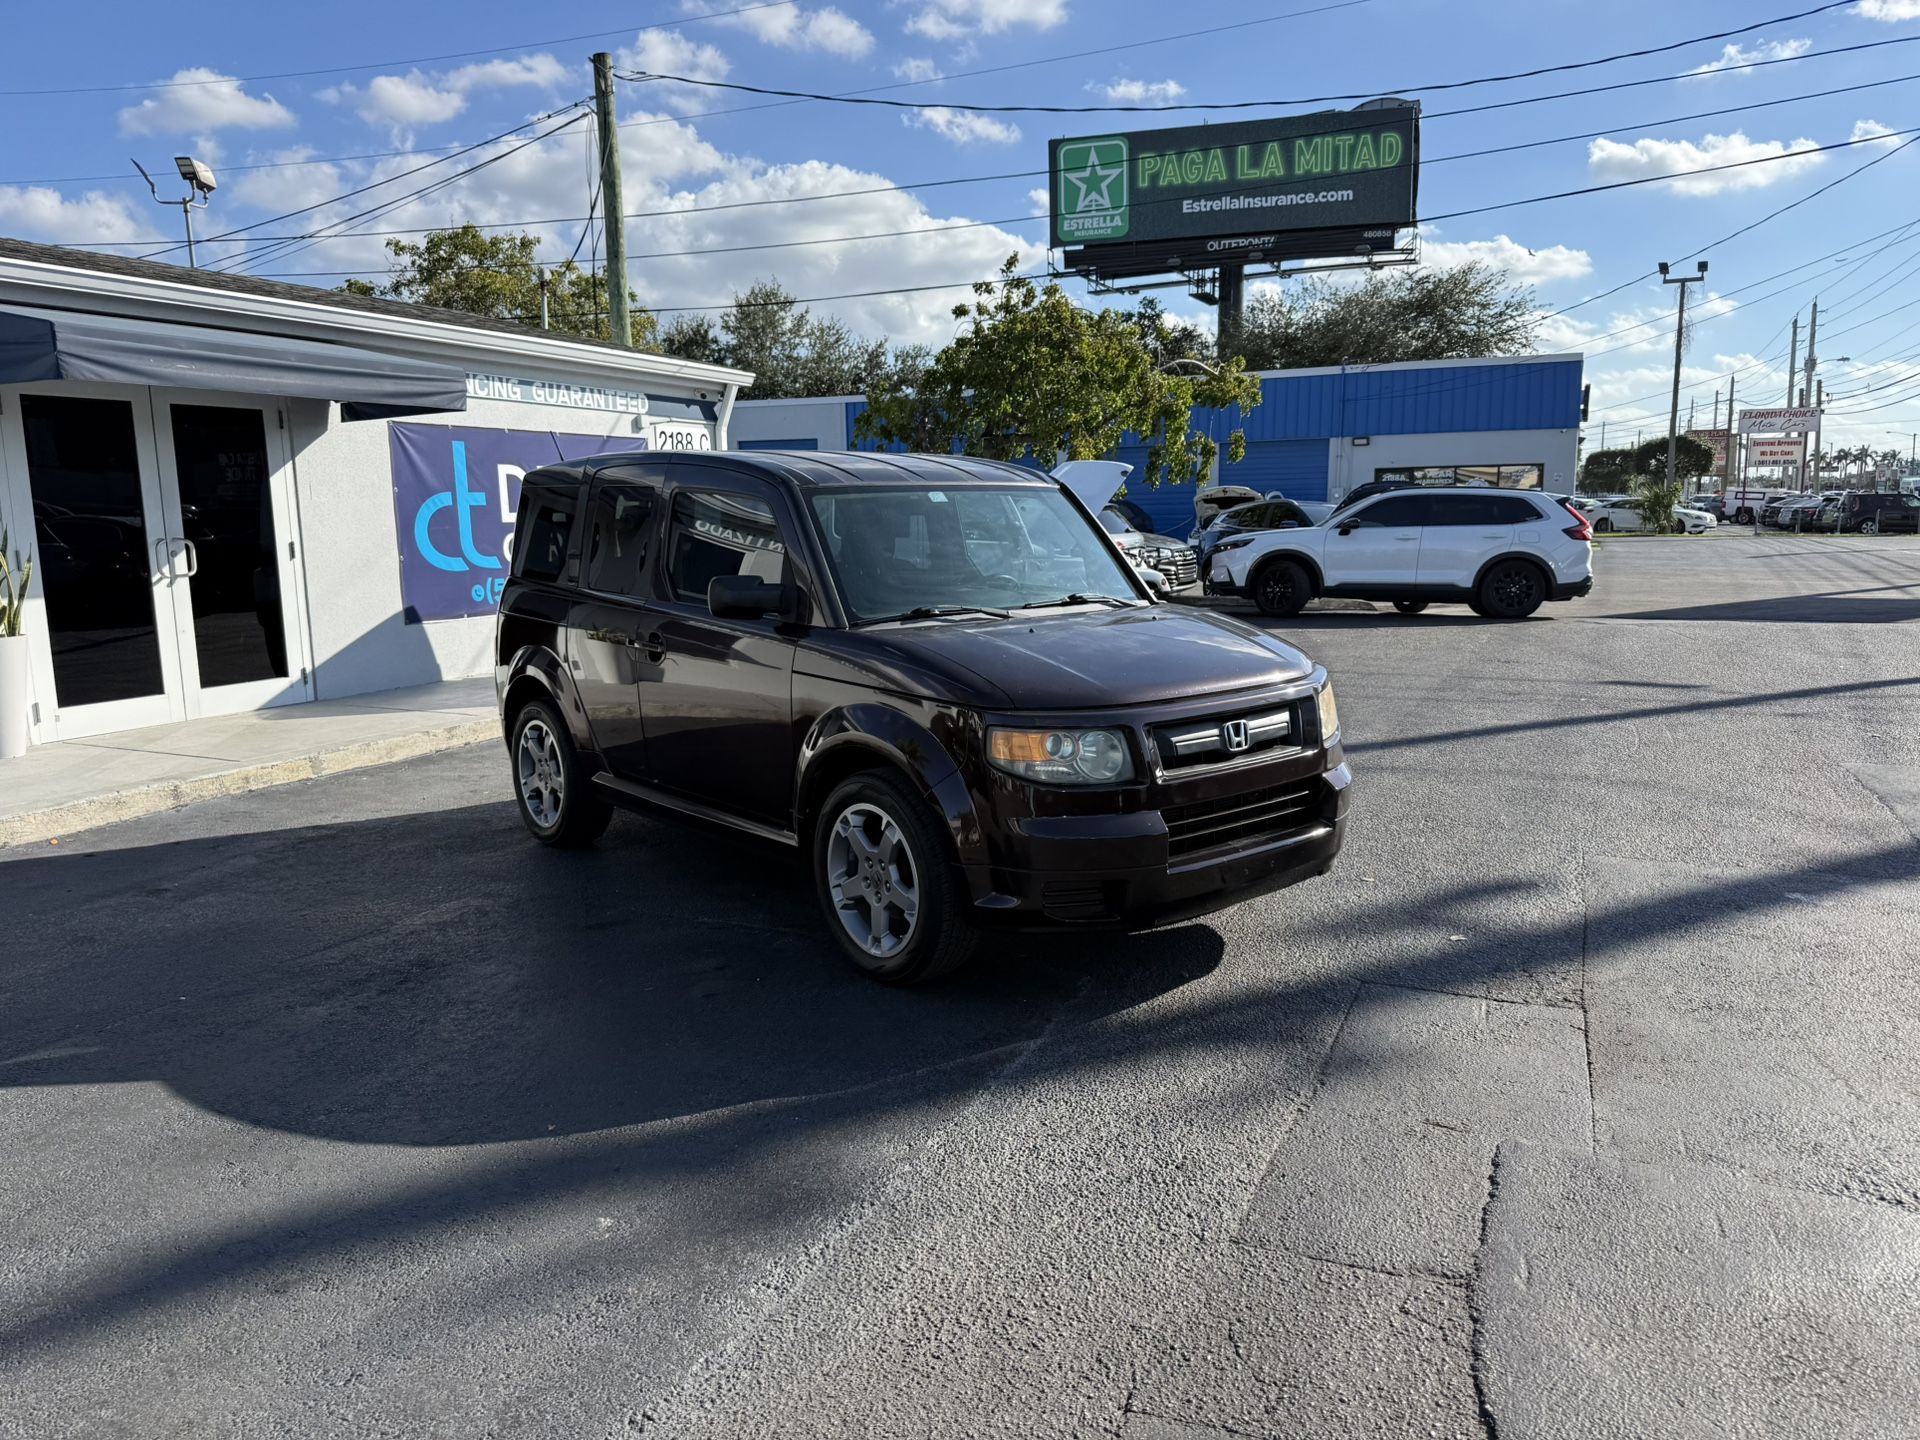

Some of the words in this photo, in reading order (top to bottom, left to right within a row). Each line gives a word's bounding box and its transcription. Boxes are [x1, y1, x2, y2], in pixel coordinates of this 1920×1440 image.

[1137, 150, 1226, 188] PAGA
[1237, 142, 1284, 180] LA
[1294, 132, 1402, 175] MITAD
[1182, 189, 1354, 214] EstrellaInsurance.com
[1063, 215, 1122, 231] ESTRELLA
[1074, 228, 1112, 237] INSURANCE
[532, 382, 649, 414] GUARANTEED
[1783, 409, 1818, 418] CHOICE
[659, 430, 694, 450] 2188
